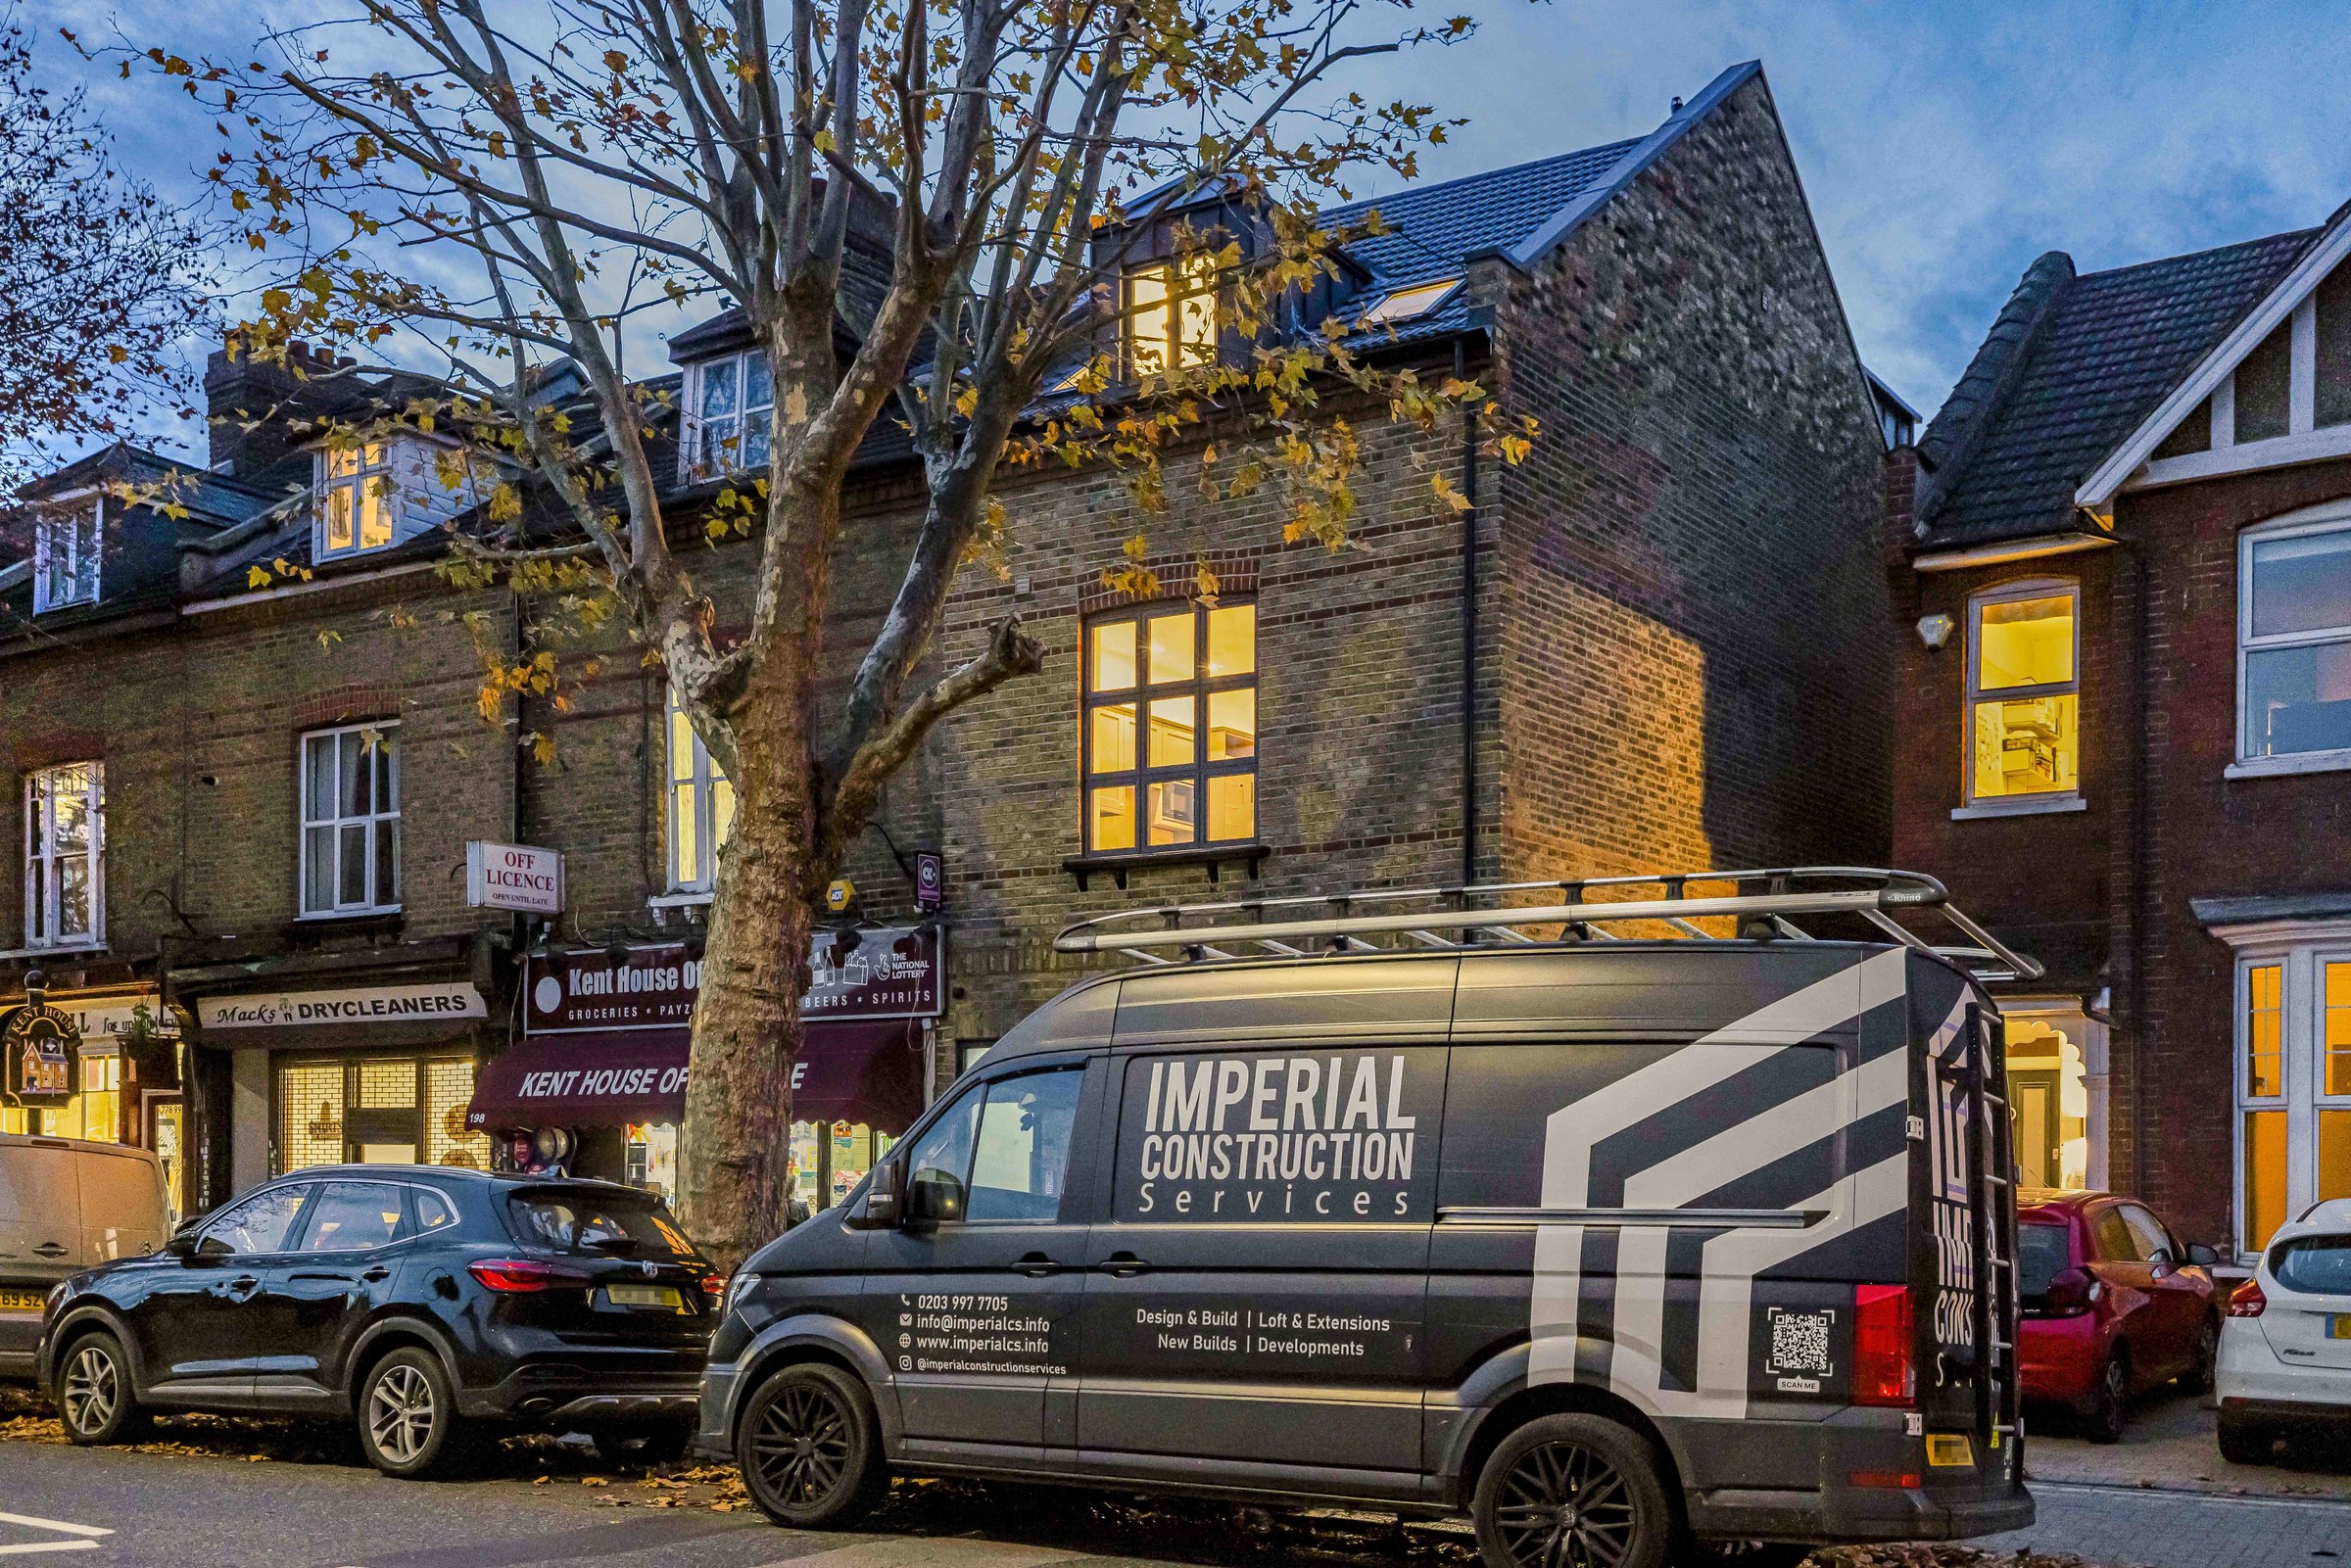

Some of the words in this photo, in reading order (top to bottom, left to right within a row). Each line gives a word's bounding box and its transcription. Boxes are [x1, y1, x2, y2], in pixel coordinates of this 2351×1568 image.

[504, 852, 535, 870] OFF
[486, 870, 555, 891] LICENCE
[492, 892, 510, 901] OPEN
[511, 894, 531, 904] UNTIL
[532, 897, 549, 906] LATE
[831, 890, 843, 901] ADT
[891, 953, 907, 962] THE
[891, 960, 930, 971] NATIONAL
[568, 968, 614, 996] Kent
[617, 965, 679, 994] House
[683, 961, 704, 990] Of
[891, 970, 926, 979] LOTTERY
[216, 1004, 276, 1024] Macks
[298, 994, 467, 1019] DRYCLEANERS
[804, 995, 848, 1009] BEERS
[872, 990, 931, 1005] SPIRITS
[11, 1006, 39, 1034] KENT
[44, 1006, 80, 1038] HOUSE
[568, 1006, 638, 1021] GROCERIES
[659, 1004, 697, 1016] PAYZ
[518, 1070, 581, 1097] KENT
[578, 1069, 659, 1096] HOUSE
[658, 1067, 690, 1094] OF
[1144, 1055, 1416, 1132] IMPERIAL
[468, 1113, 486, 1124] 198
[1140, 1132, 1415, 1180] CONSTRUCTION
[1138, 1182, 1409, 1215] Services
[918, 1295, 948, 1309] 0203
[952, 1296, 975, 1310] 997
[978, 1297, 1008, 1311] 7705
[917, 1313, 1050, 1333] info@imperialcs.info
[1136, 1308, 1183, 1328] Design
[1187, 1310, 1197, 1325] &
[1202, 1310, 1238, 1326] Build
[1259, 1312, 1287, 1328] Loft
[1291, 1313, 1303, 1329] &
[1307, 1313, 1390, 1331] Extensions
[917, 1336, 1049, 1354] www.imperialcs.info
[1158, 1333, 1188, 1350] New
[1193, 1335, 1237, 1352] Builds
[1258, 1337, 1365, 1357] Developments
[917, 1358, 1067, 1375] @imperialconstructionservices
